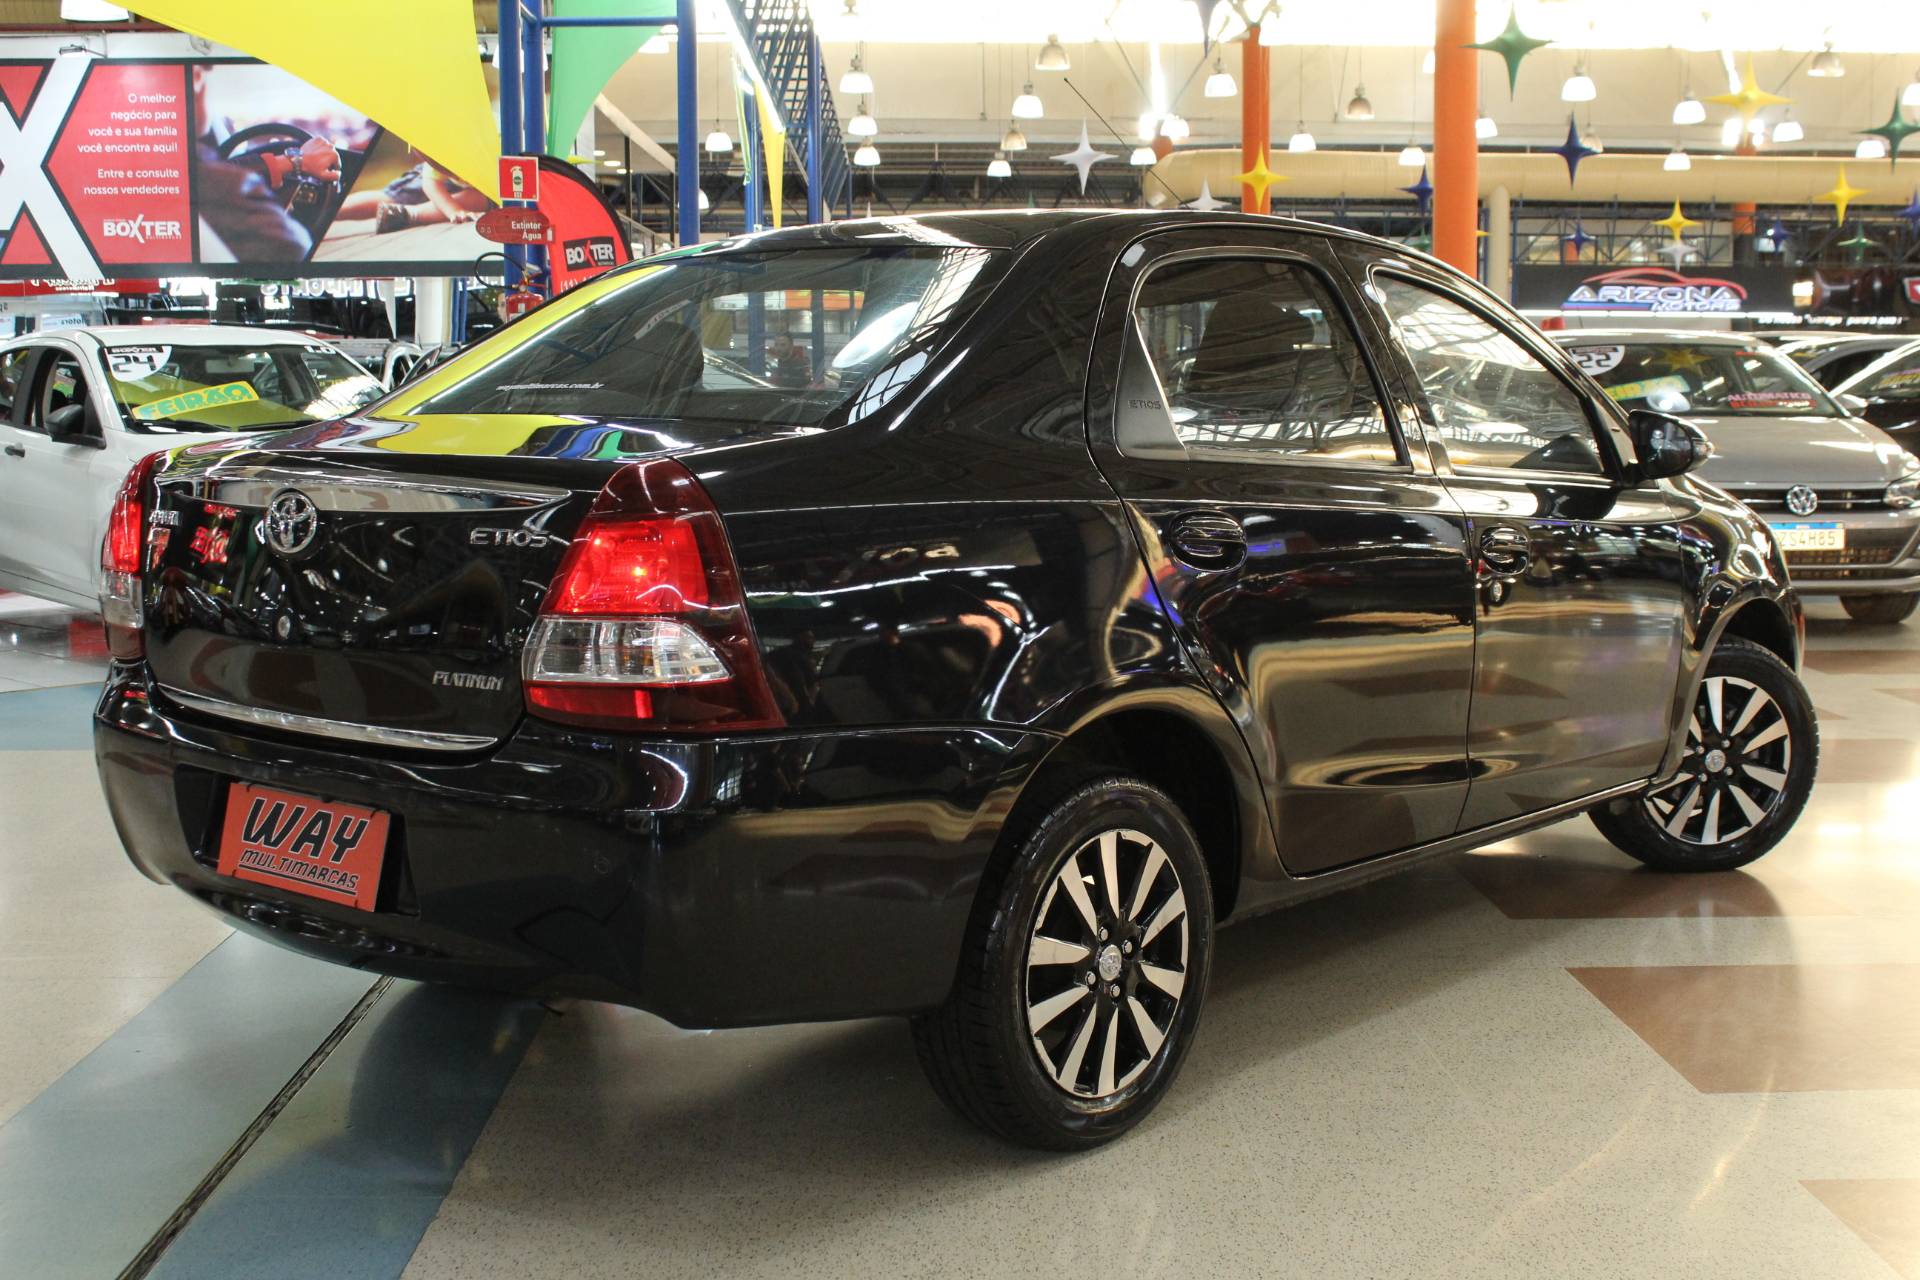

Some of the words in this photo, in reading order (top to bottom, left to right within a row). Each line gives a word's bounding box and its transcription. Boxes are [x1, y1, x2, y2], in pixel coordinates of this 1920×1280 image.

[128, 93, 137, 103] O
[140, 93, 176, 103] melhor
[111, 110, 152, 121] negócio
[154, 111, 177, 121] para
[88, 126, 112, 136] você
[115, 128, 121, 136] e
[124, 128, 141, 136] sua
[144, 126, 177, 136] família
[77, 142, 102, 152] você
[105, 143, 150, 152] encontra
[97, 168, 124, 178] Entre
[127, 170, 133, 178] e
[135, 168, 179, 178] consulte
[84, 186, 118, 195] nossos
[120, 184, 179, 195] vendedores
[103, 213, 182, 243] BOXTER
[511, 220, 541, 229] Extintor
[565, 240, 615, 267] BOXTER
[1567, 285, 1740, 302] ARIZONA
[1650, 300, 1741, 312] MOTORS
[112, 354, 157, 373] 24
[1127, 400, 1161, 410] ETIOS
[470, 527, 549, 548] ETIOS
[432, 671, 504, 691] PLATINUM
[241, 797, 371, 864] WAY
[239, 849, 361, 889] MULTIMARCAS
